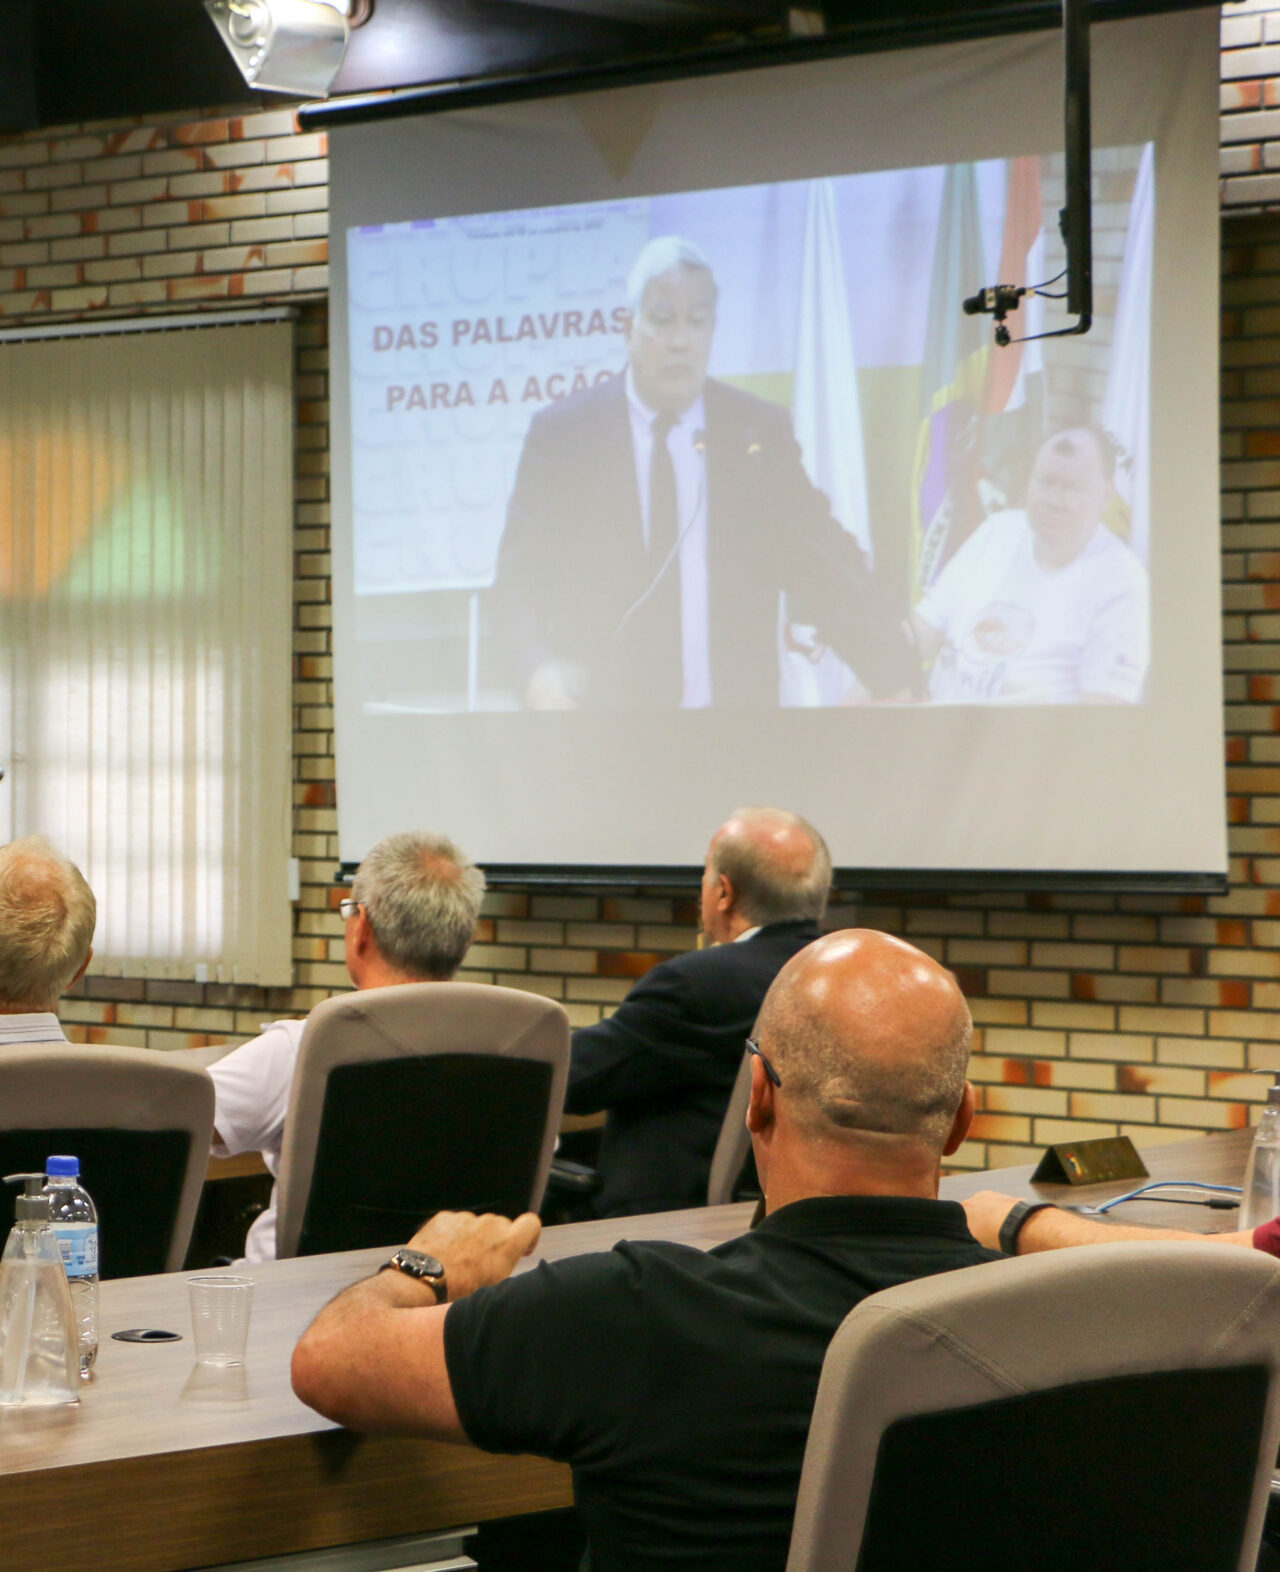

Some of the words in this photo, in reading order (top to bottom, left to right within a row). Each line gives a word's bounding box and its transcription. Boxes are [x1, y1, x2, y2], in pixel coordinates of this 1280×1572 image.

[372, 321, 439, 352] DAS
[452, 306, 632, 347] PALAVRAS
[386, 380, 475, 412] PARA
[487, 378, 509, 405] A
